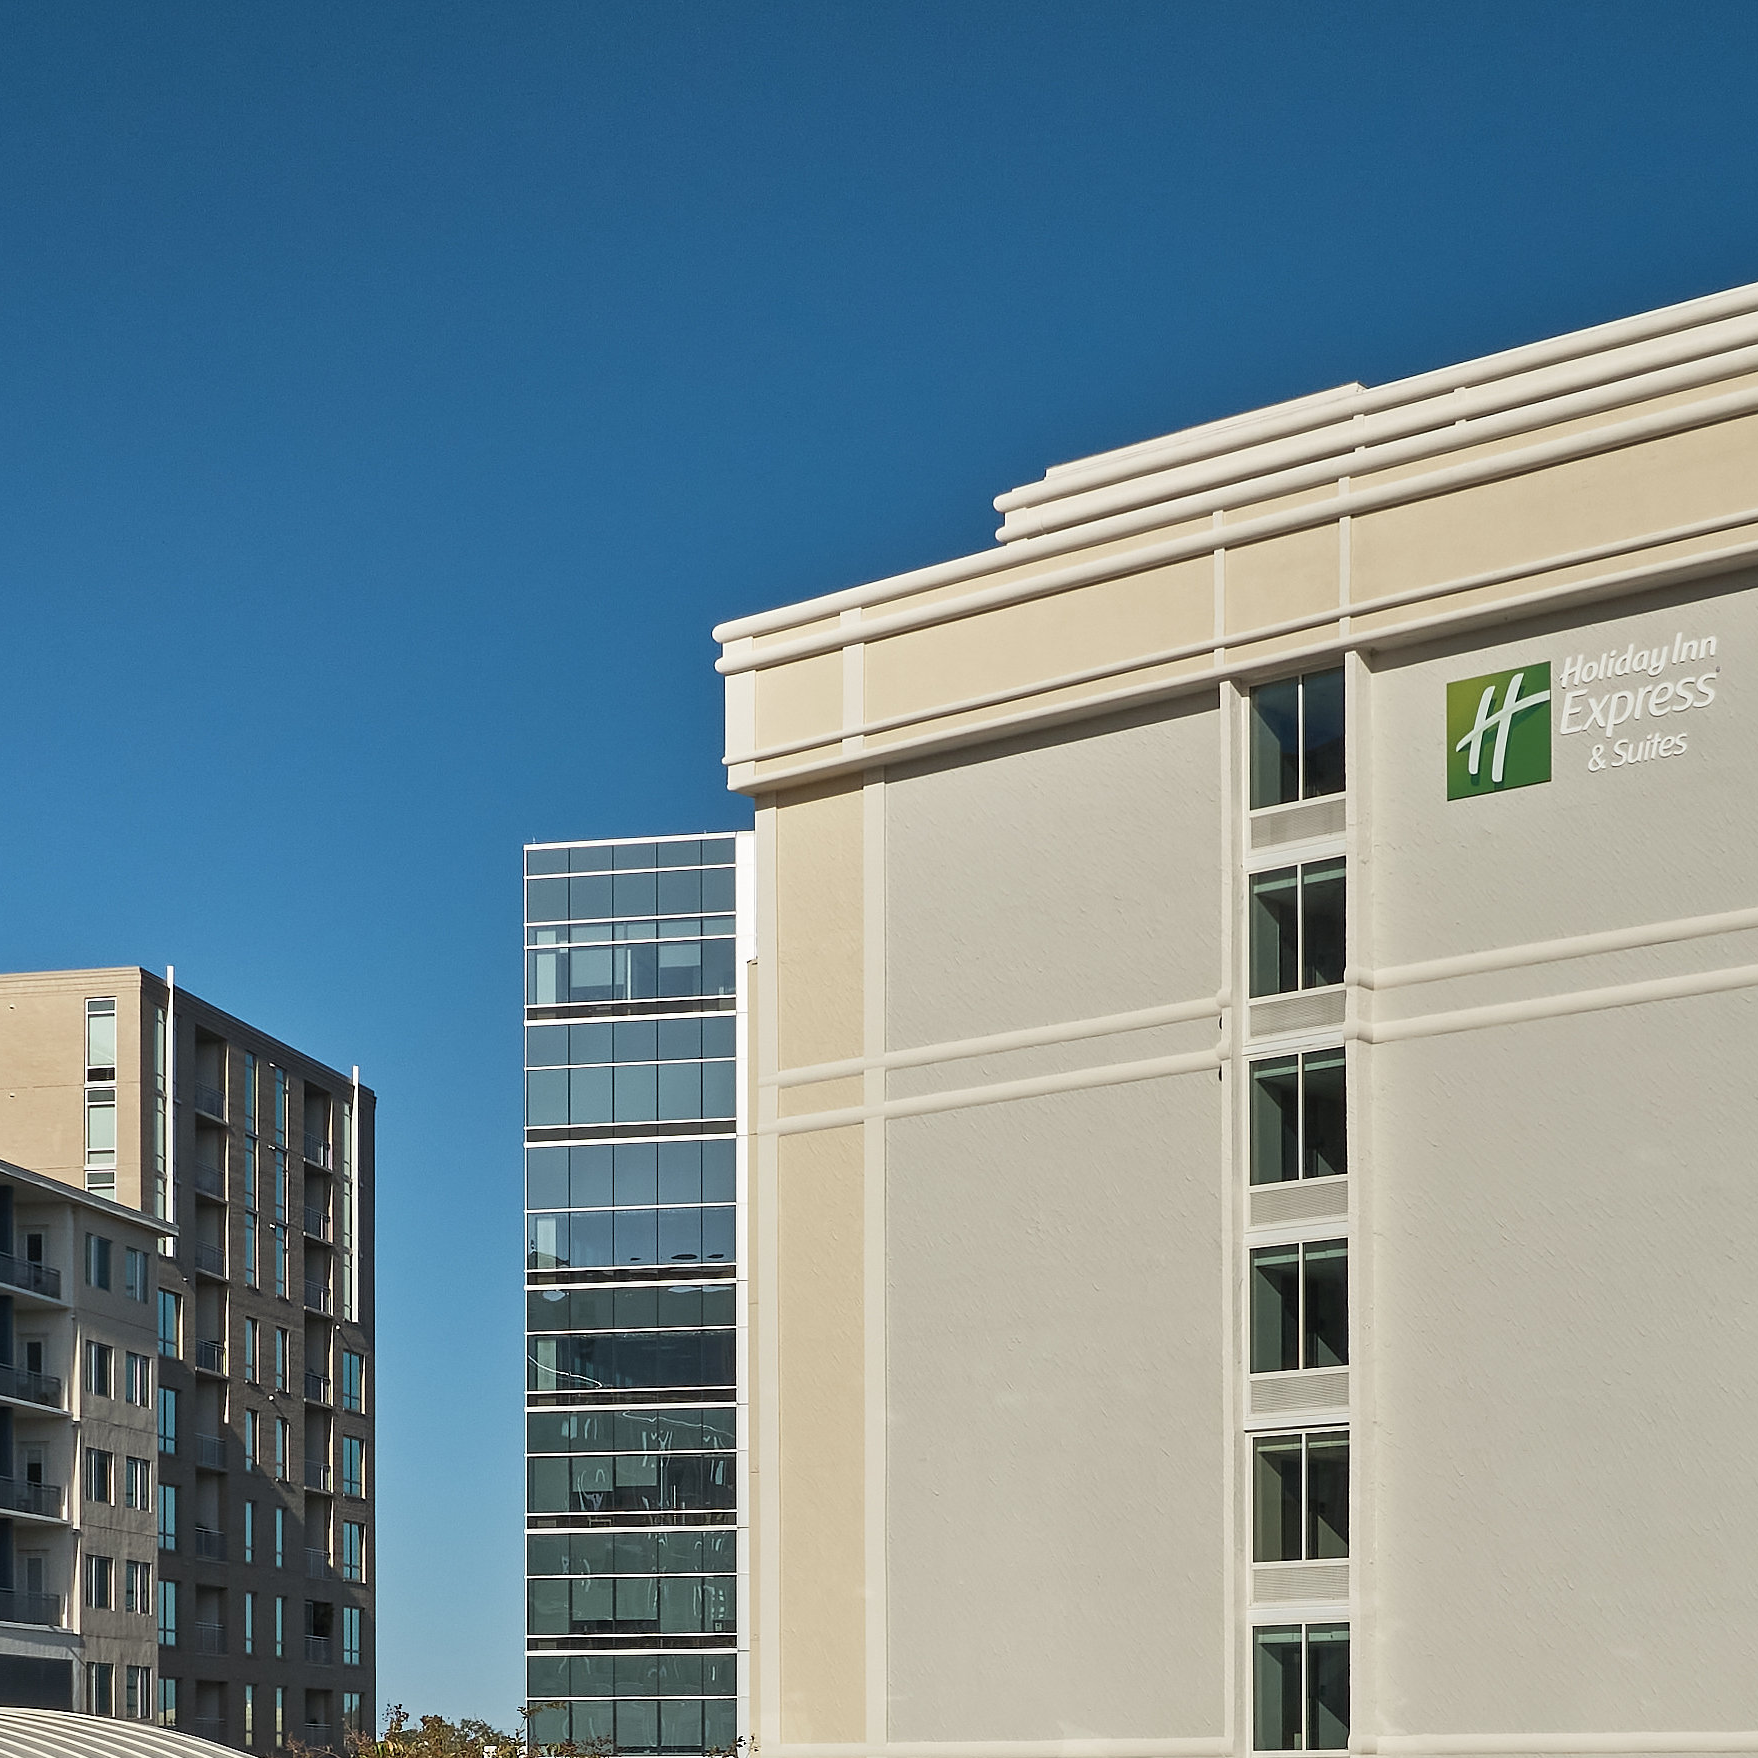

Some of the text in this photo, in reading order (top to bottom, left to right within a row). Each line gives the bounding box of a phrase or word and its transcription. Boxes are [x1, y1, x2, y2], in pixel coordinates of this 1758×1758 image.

[1560, 632, 1717, 689] Holiday Inn
[1559, 673, 1718, 737] Express
[1587, 732, 1688, 773] & Suites
